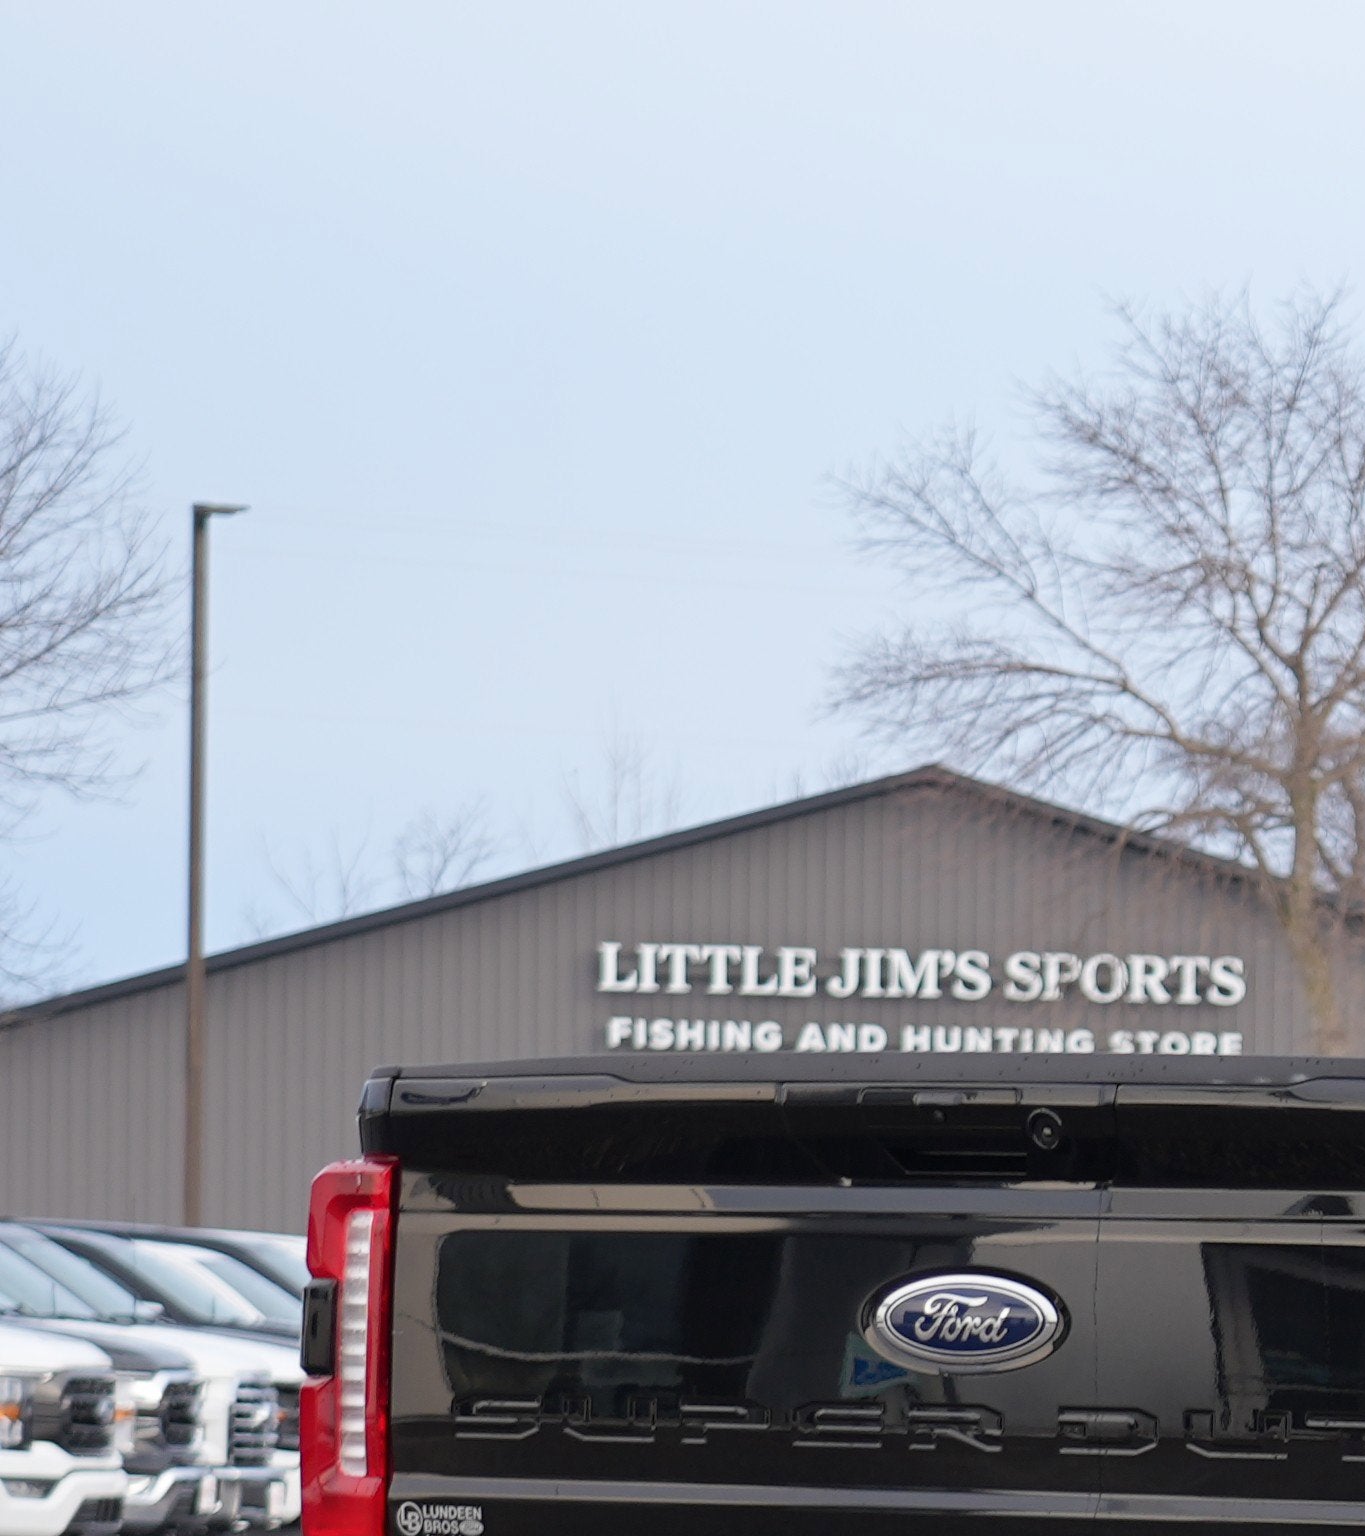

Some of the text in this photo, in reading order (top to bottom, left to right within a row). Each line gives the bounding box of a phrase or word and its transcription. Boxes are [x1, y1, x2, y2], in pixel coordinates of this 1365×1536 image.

[597, 941, 1246, 1006] LITTLE JIM'S SPORTS
[606, 1016, 1243, 1056] FISHING AND HUNTING STORE
[913, 1292, 1011, 1344] Ford
[452, 1397, 1004, 1453] SUPER
[423, 1505, 481, 1520] LUNDEEN
[423, 1520, 459, 1535] BROS
